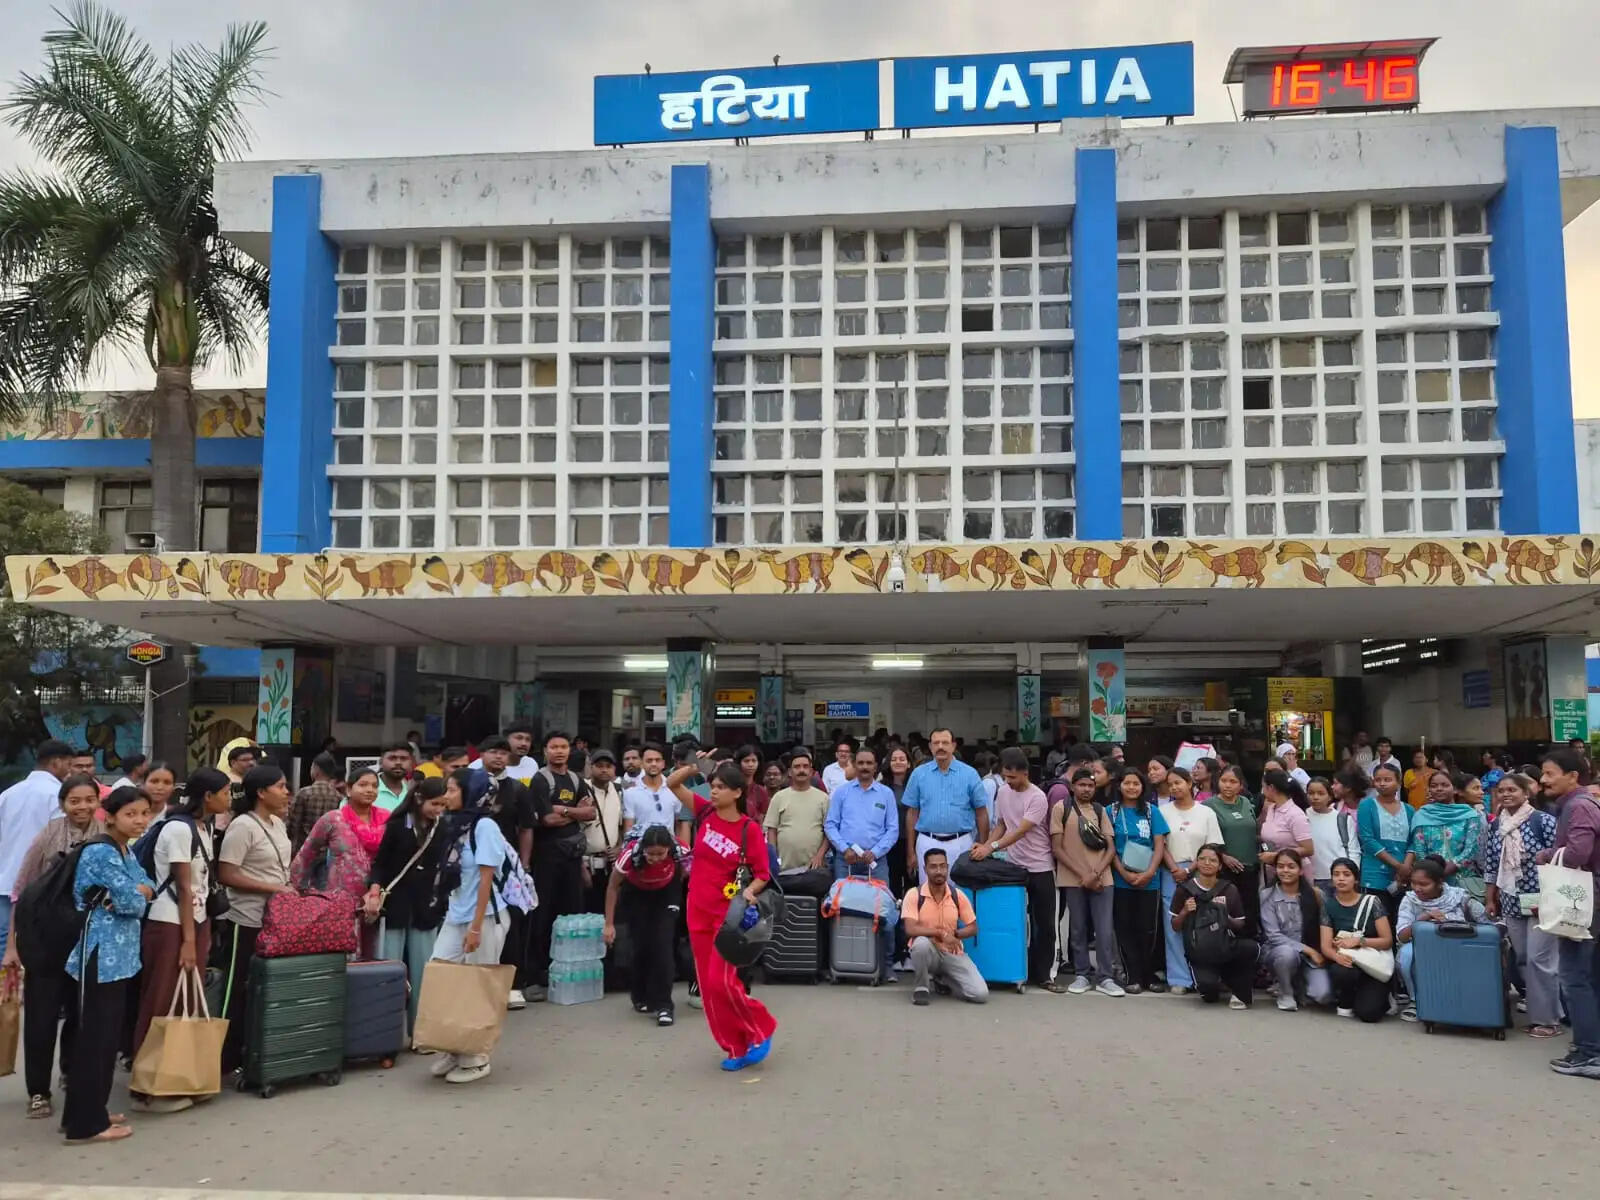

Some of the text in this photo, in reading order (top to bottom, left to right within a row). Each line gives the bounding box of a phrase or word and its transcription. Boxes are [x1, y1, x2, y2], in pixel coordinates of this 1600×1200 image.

[659, 75, 810, 130] हटिया
[934, 57, 1151, 111] HATIA
[1272, 58, 1416, 106] 16:46
[130, 647, 161, 656] MONGIA
